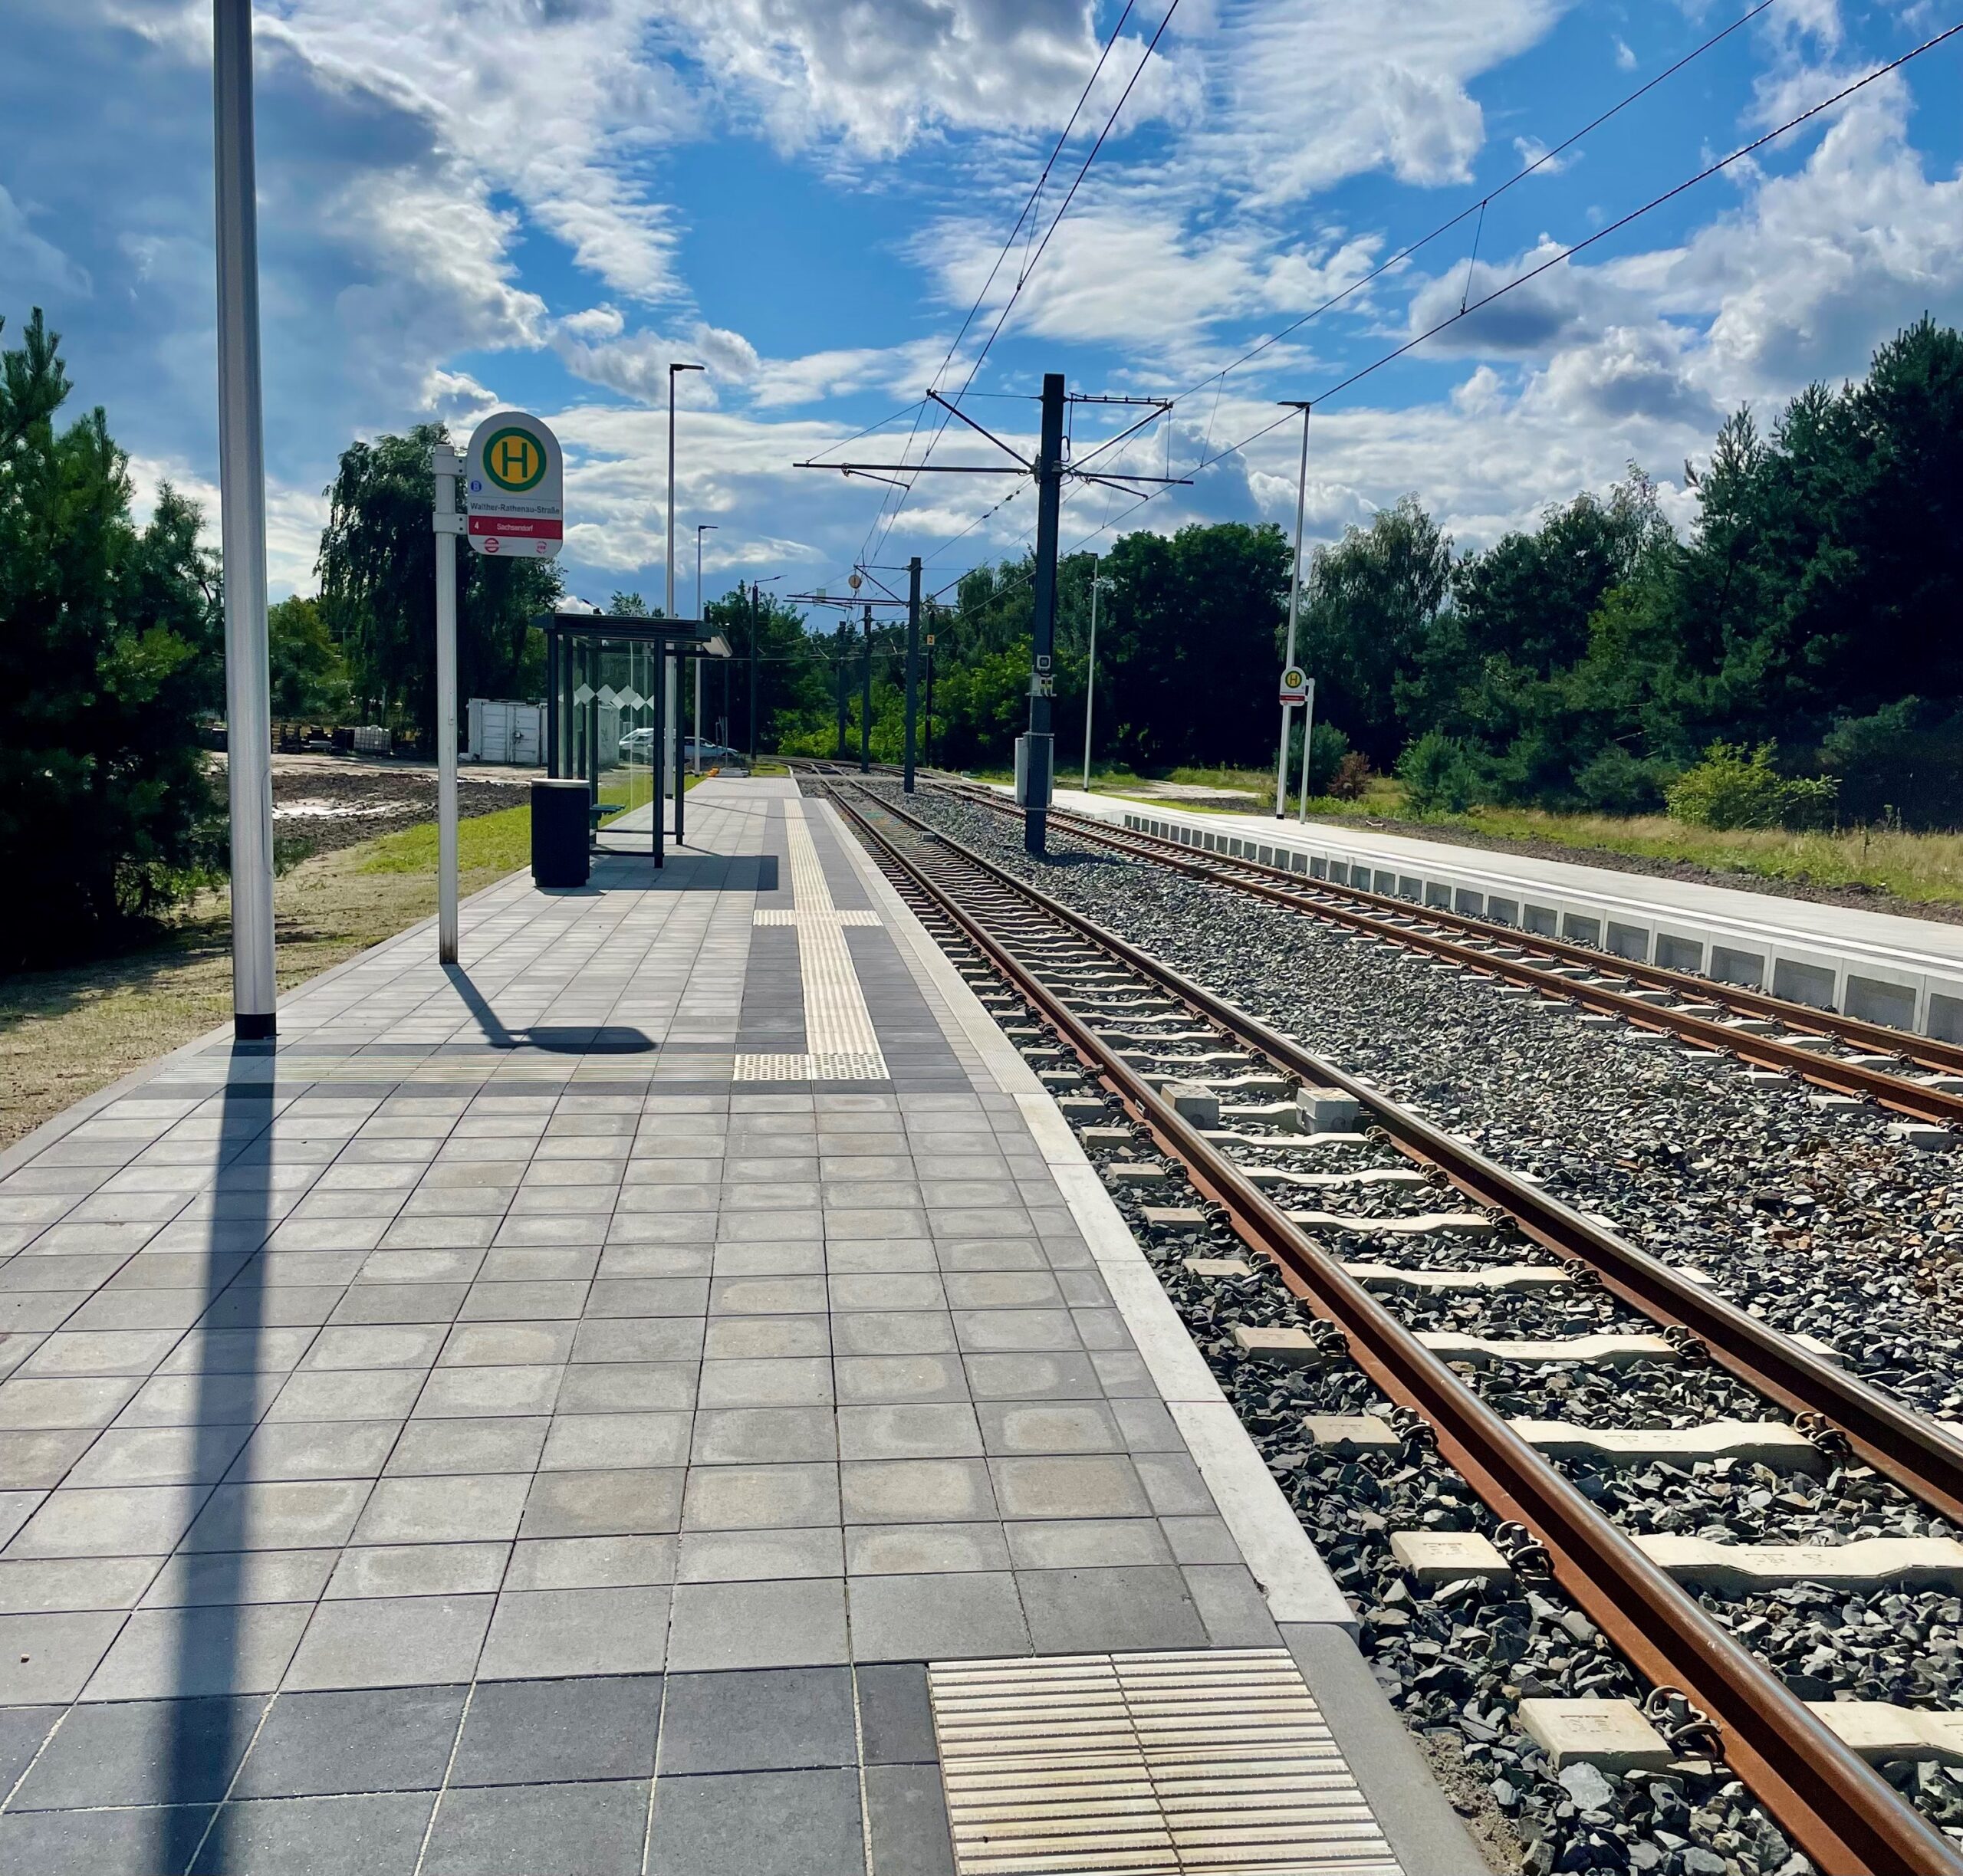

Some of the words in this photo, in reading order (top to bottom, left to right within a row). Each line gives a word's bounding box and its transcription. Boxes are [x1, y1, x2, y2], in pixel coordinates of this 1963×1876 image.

[502, 442, 528, 478] H
[470, 502, 560, 514] Walther-Rathenau-Straße
[474, 521, 479, 530] 4
[496, 523, 534, 532] Sachsendorf
[1290, 675, 1297, 684] H
